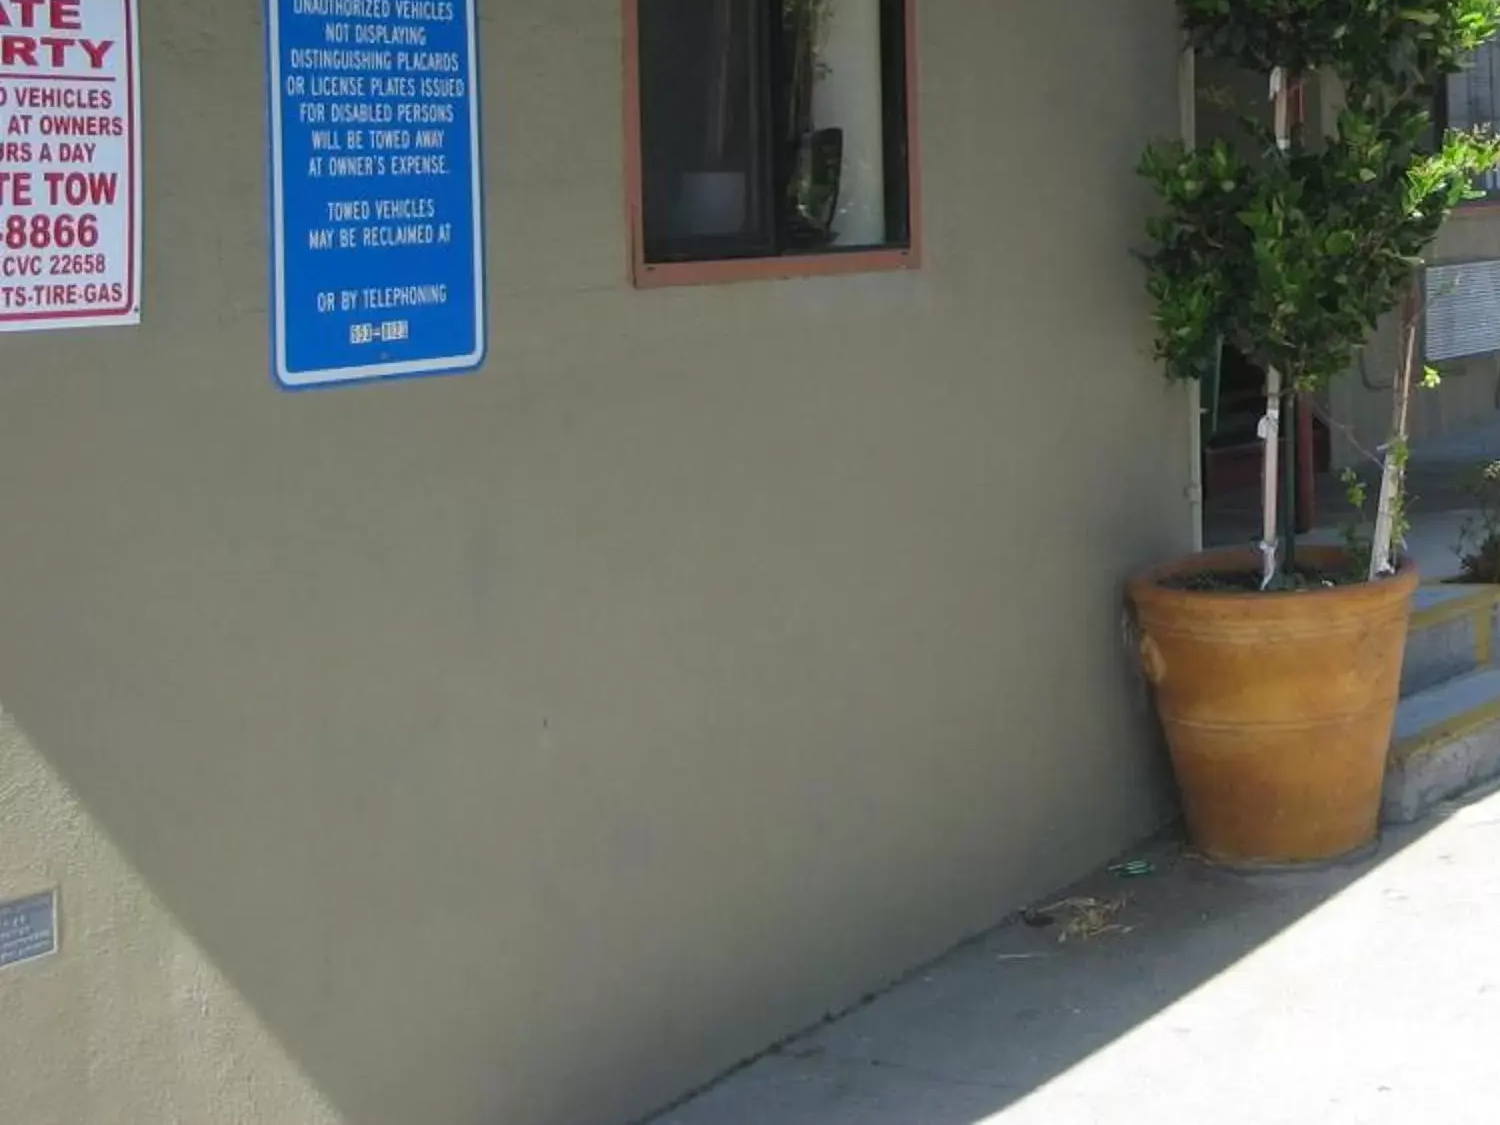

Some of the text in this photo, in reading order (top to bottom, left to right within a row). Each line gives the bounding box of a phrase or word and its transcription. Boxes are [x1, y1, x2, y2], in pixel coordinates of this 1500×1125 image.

[395, 0, 453, 20] VEHICLES
[325, 22, 427, 45] NOT DISPLAYING
[291, 49, 460, 71] DISTINGUISHING PLACARDS
[287, 76, 465, 97] OR LICENSE PLATES ISSUED
[14, 87, 112, 109] VEHICLES
[300, 103, 454, 123] FOR DISABLED PERSONS
[8, 115, 123, 136] AT OWNERS
[311, 130, 445, 150] WILL BE TOWED AWAY
[40, 143, 52, 163] A
[60, 143, 96, 163] DAY
[309, 157, 322, 176] AT
[329, 154, 385, 175] OWNER'S
[44, 172, 117, 206] TOW
[327, 198, 436, 222] TOWED VEHICLES
[0, 213, 98, 249] 8866
[309, 223, 451, 250] MAY BE RECLAIMED AT
[3, 253, 106, 276] CVC 22658
[317, 283, 447, 313] OR BY TELEPHONING
